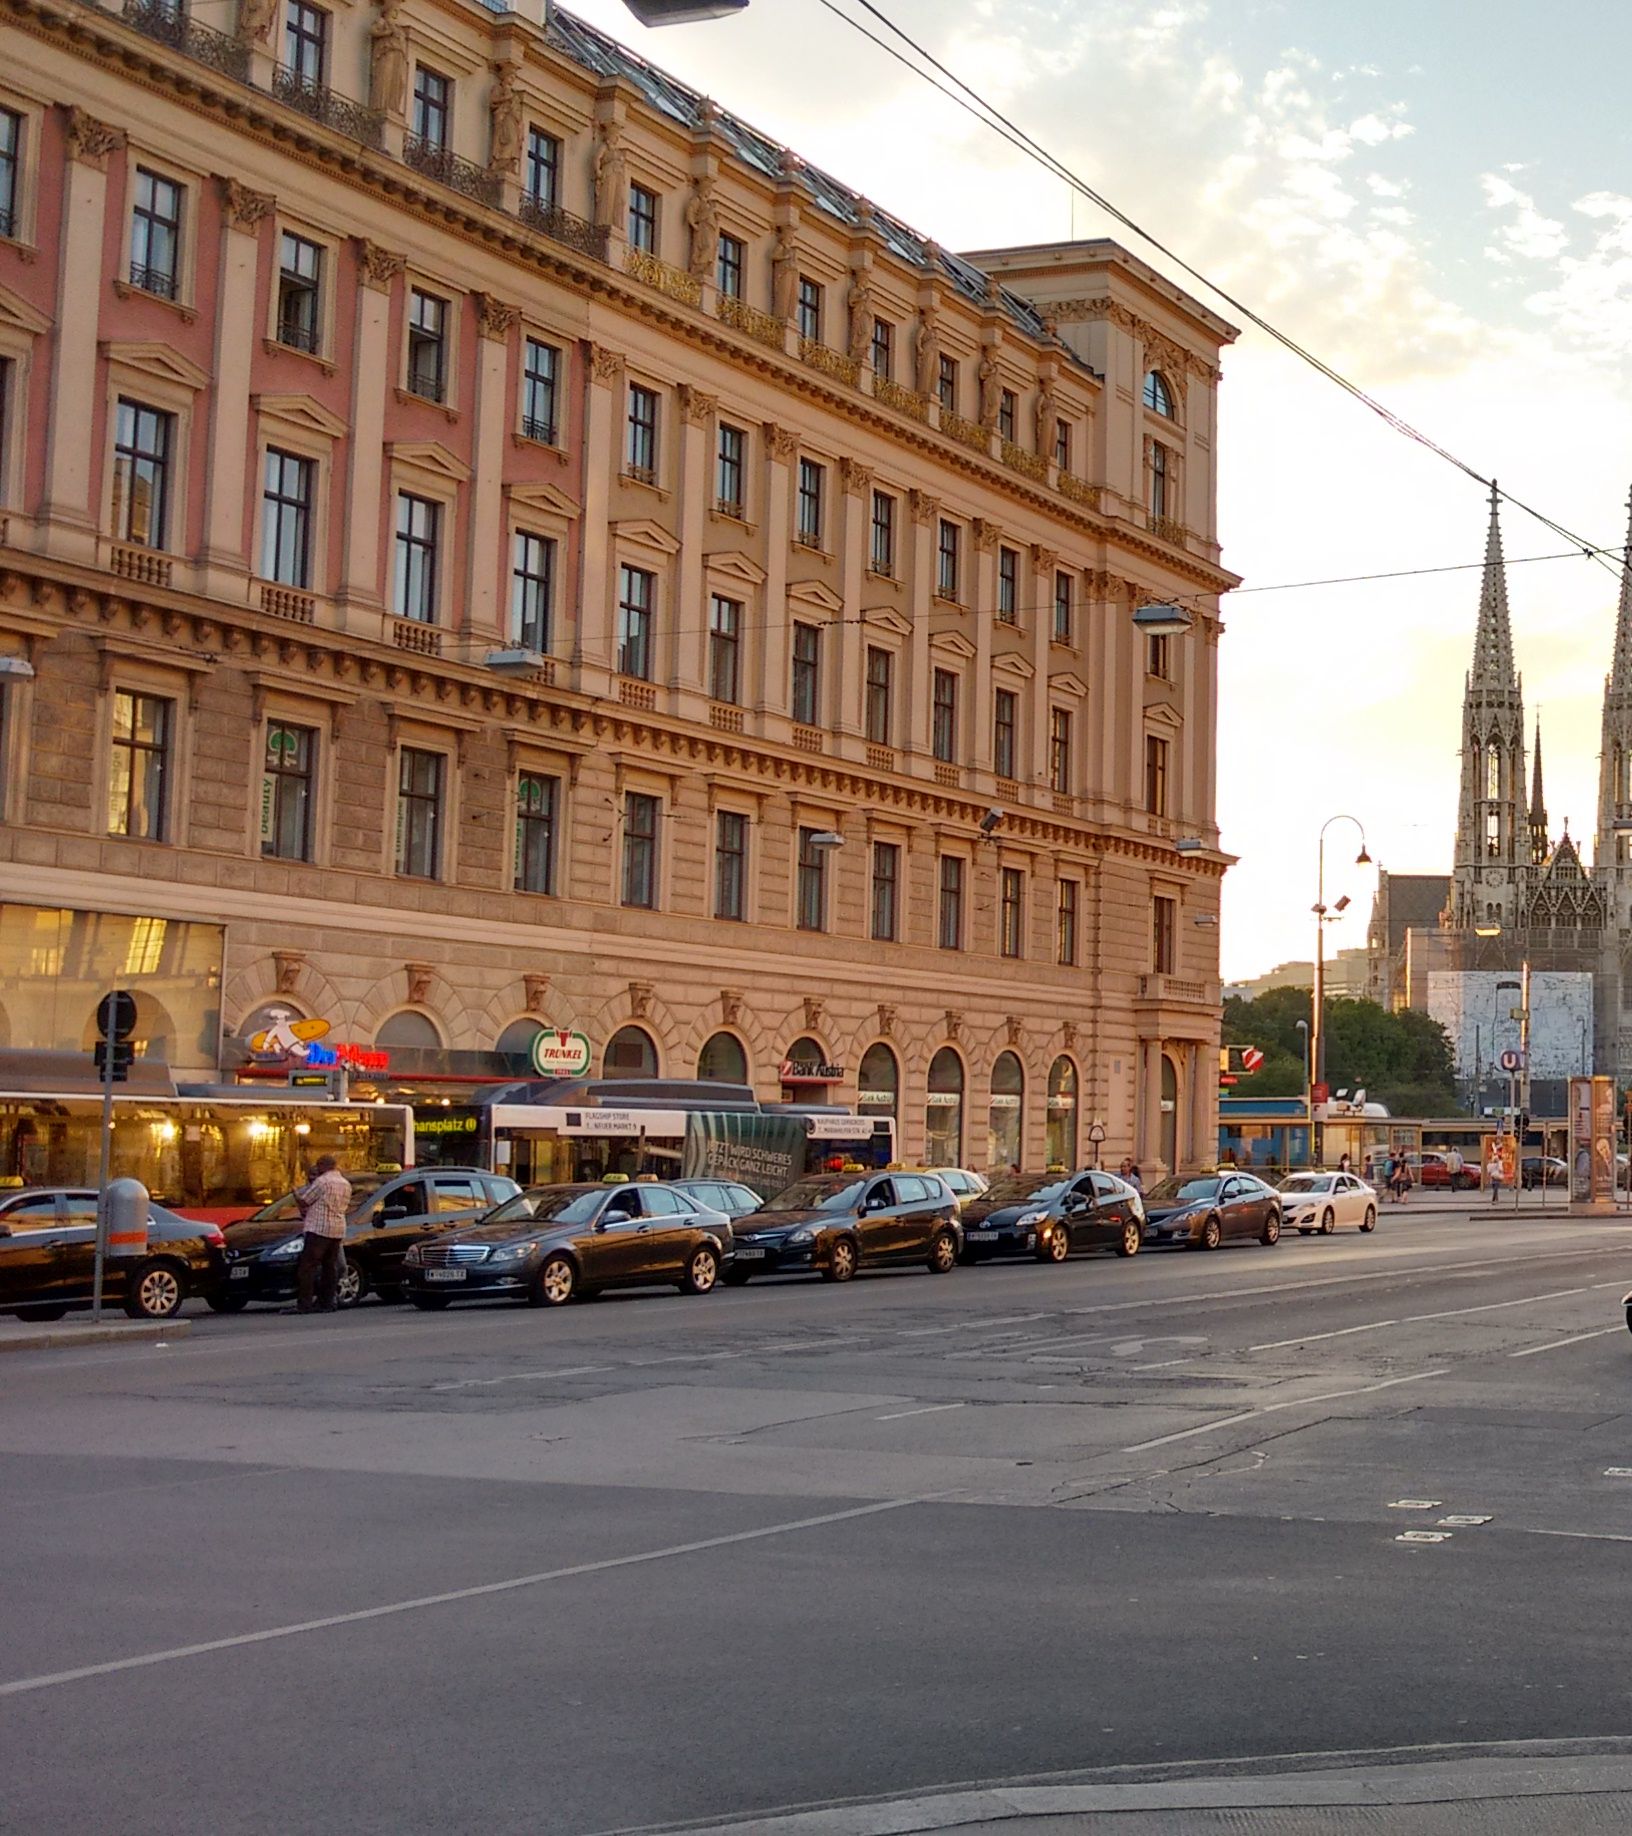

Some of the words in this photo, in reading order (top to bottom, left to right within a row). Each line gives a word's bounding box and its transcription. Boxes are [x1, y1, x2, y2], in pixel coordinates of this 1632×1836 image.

[261, 778, 273, 834] beauty
[1503, 1053, 1516, 1068] U
[793, 1060, 812, 1076] Bank
[815, 1062, 844, 1078] Austria
[612, 1112, 629, 1121] STORE
[730, 1143, 752, 1158] WIRD
[752, 1148, 792, 1166] SCHWERES
[739, 1158, 761, 1173] GANZ
